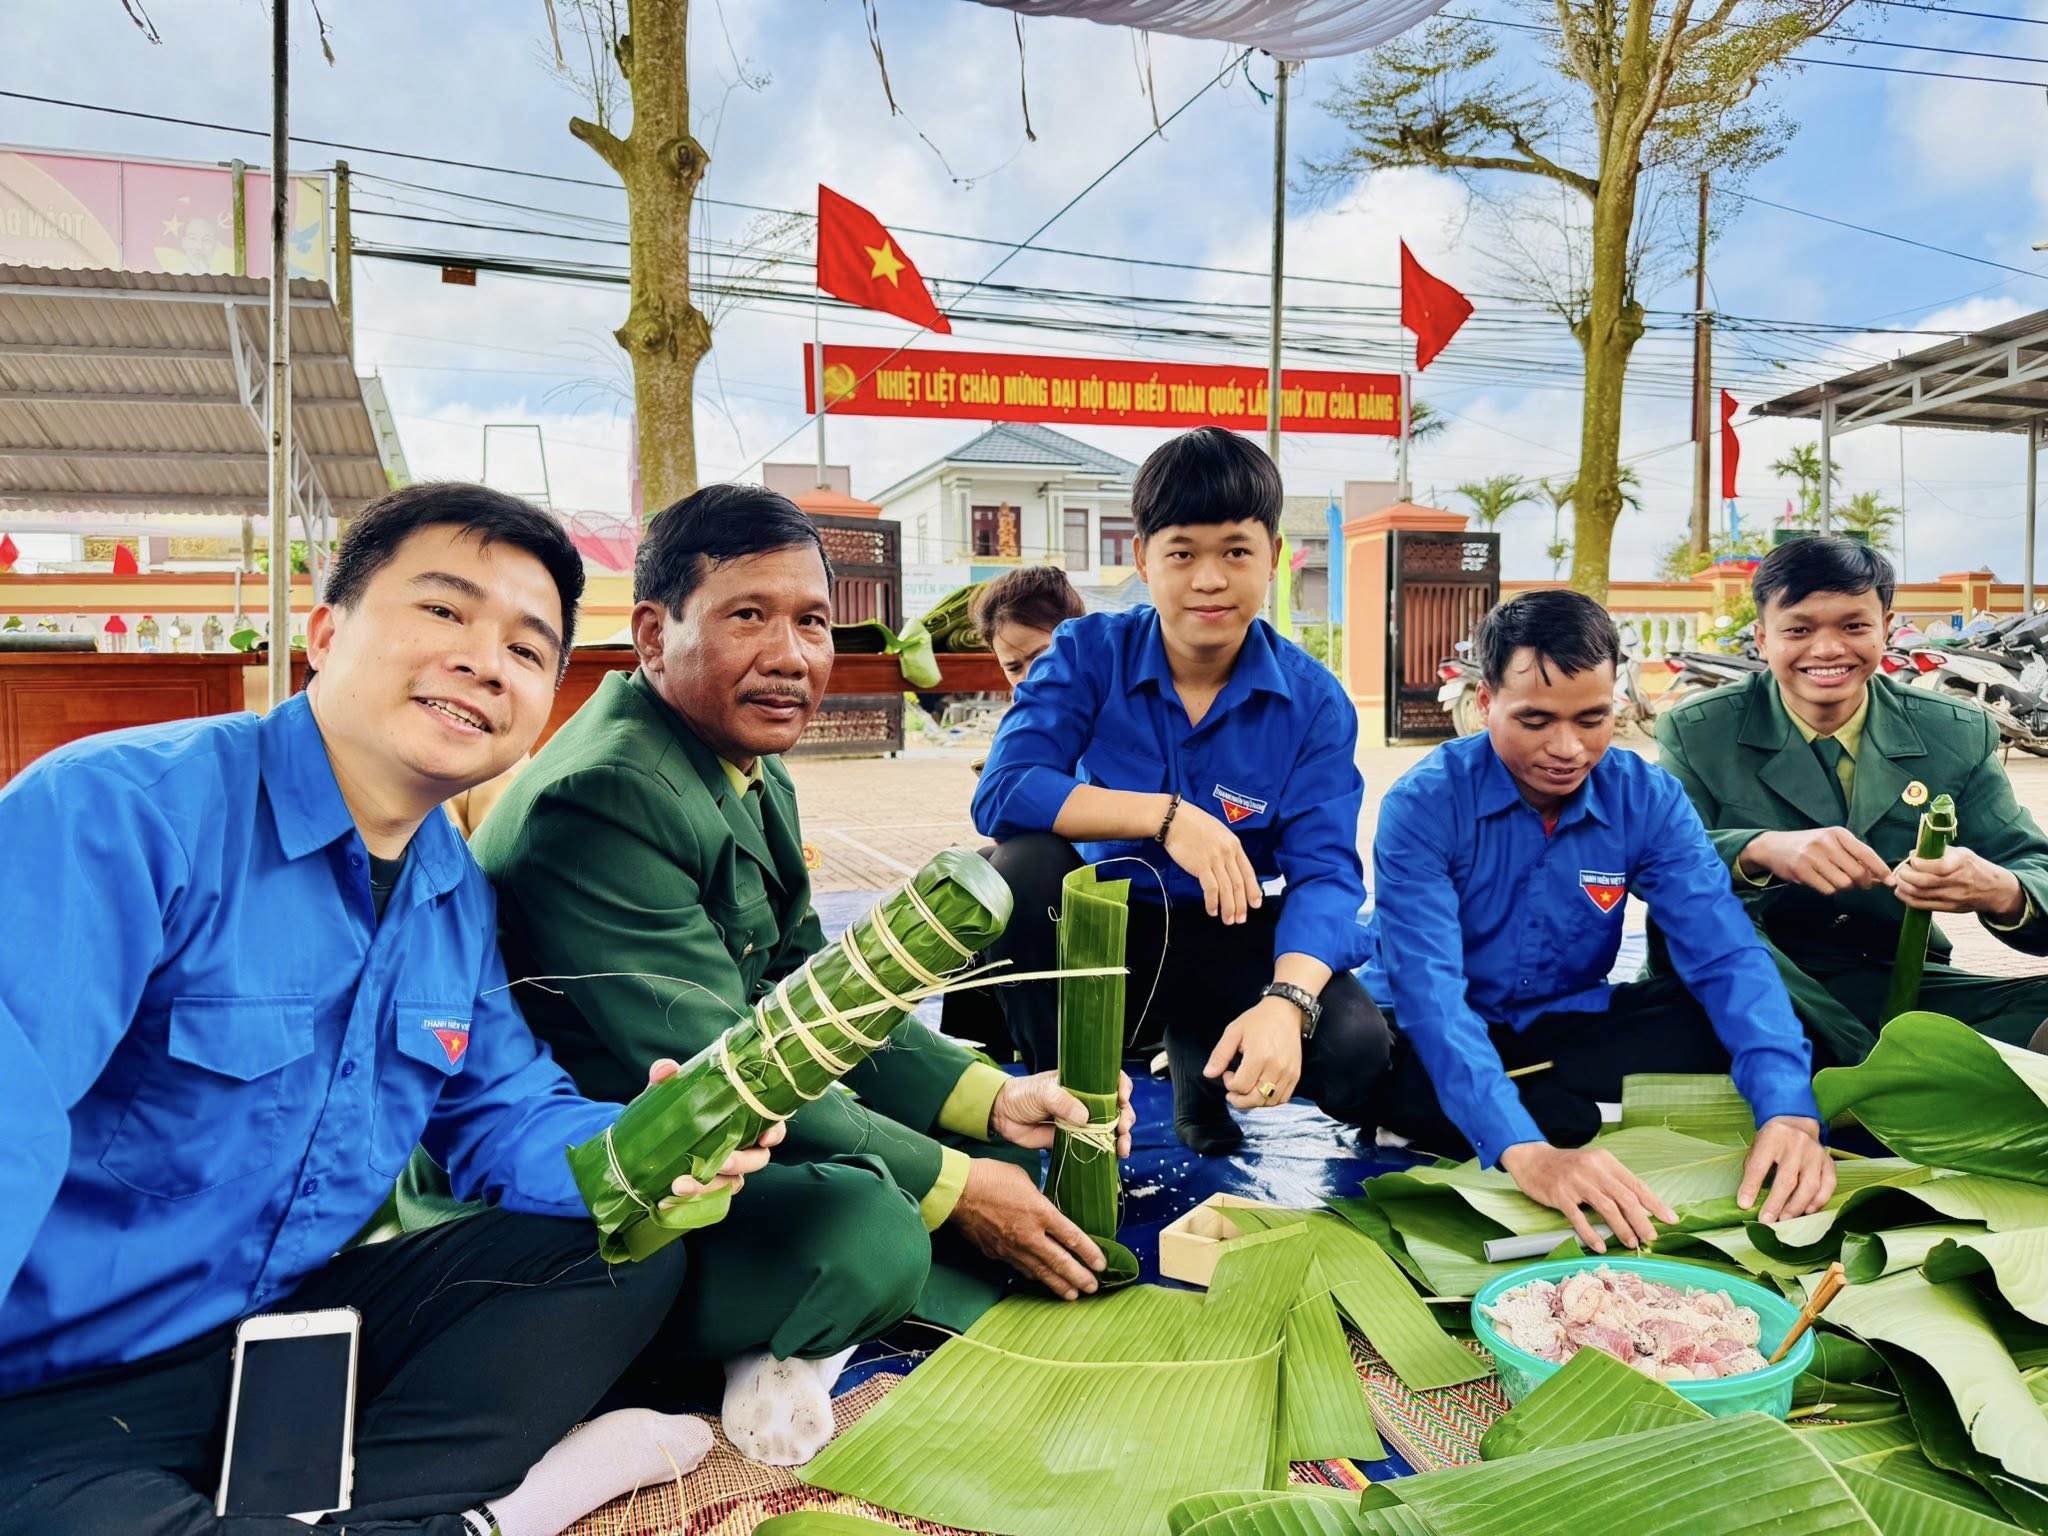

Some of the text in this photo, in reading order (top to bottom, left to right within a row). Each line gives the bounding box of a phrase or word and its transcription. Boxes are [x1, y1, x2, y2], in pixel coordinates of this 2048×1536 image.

[876, 365, 921, 408] NHIỆT
[925, 366, 957, 408] LIỆT
[959, 368, 1000, 405] CHÀO
[1003, 370, 1048, 407] MỪNG
[1051, 378, 1077, 415] ĐẠI
[1079, 374, 1105, 416] HỘI
[1107, 381, 1131, 417] ĐẠI
[1134, 372, 1167, 412] BIỂU
[1168, 379, 1206, 414] TOÀN
[1208, 377, 1245, 417] QUỐC
[1304, 390, 1327, 419] XIV
[1328, 382, 1356, 420] CỦA
[1357, 384, 1394, 421] ĐẢNG
